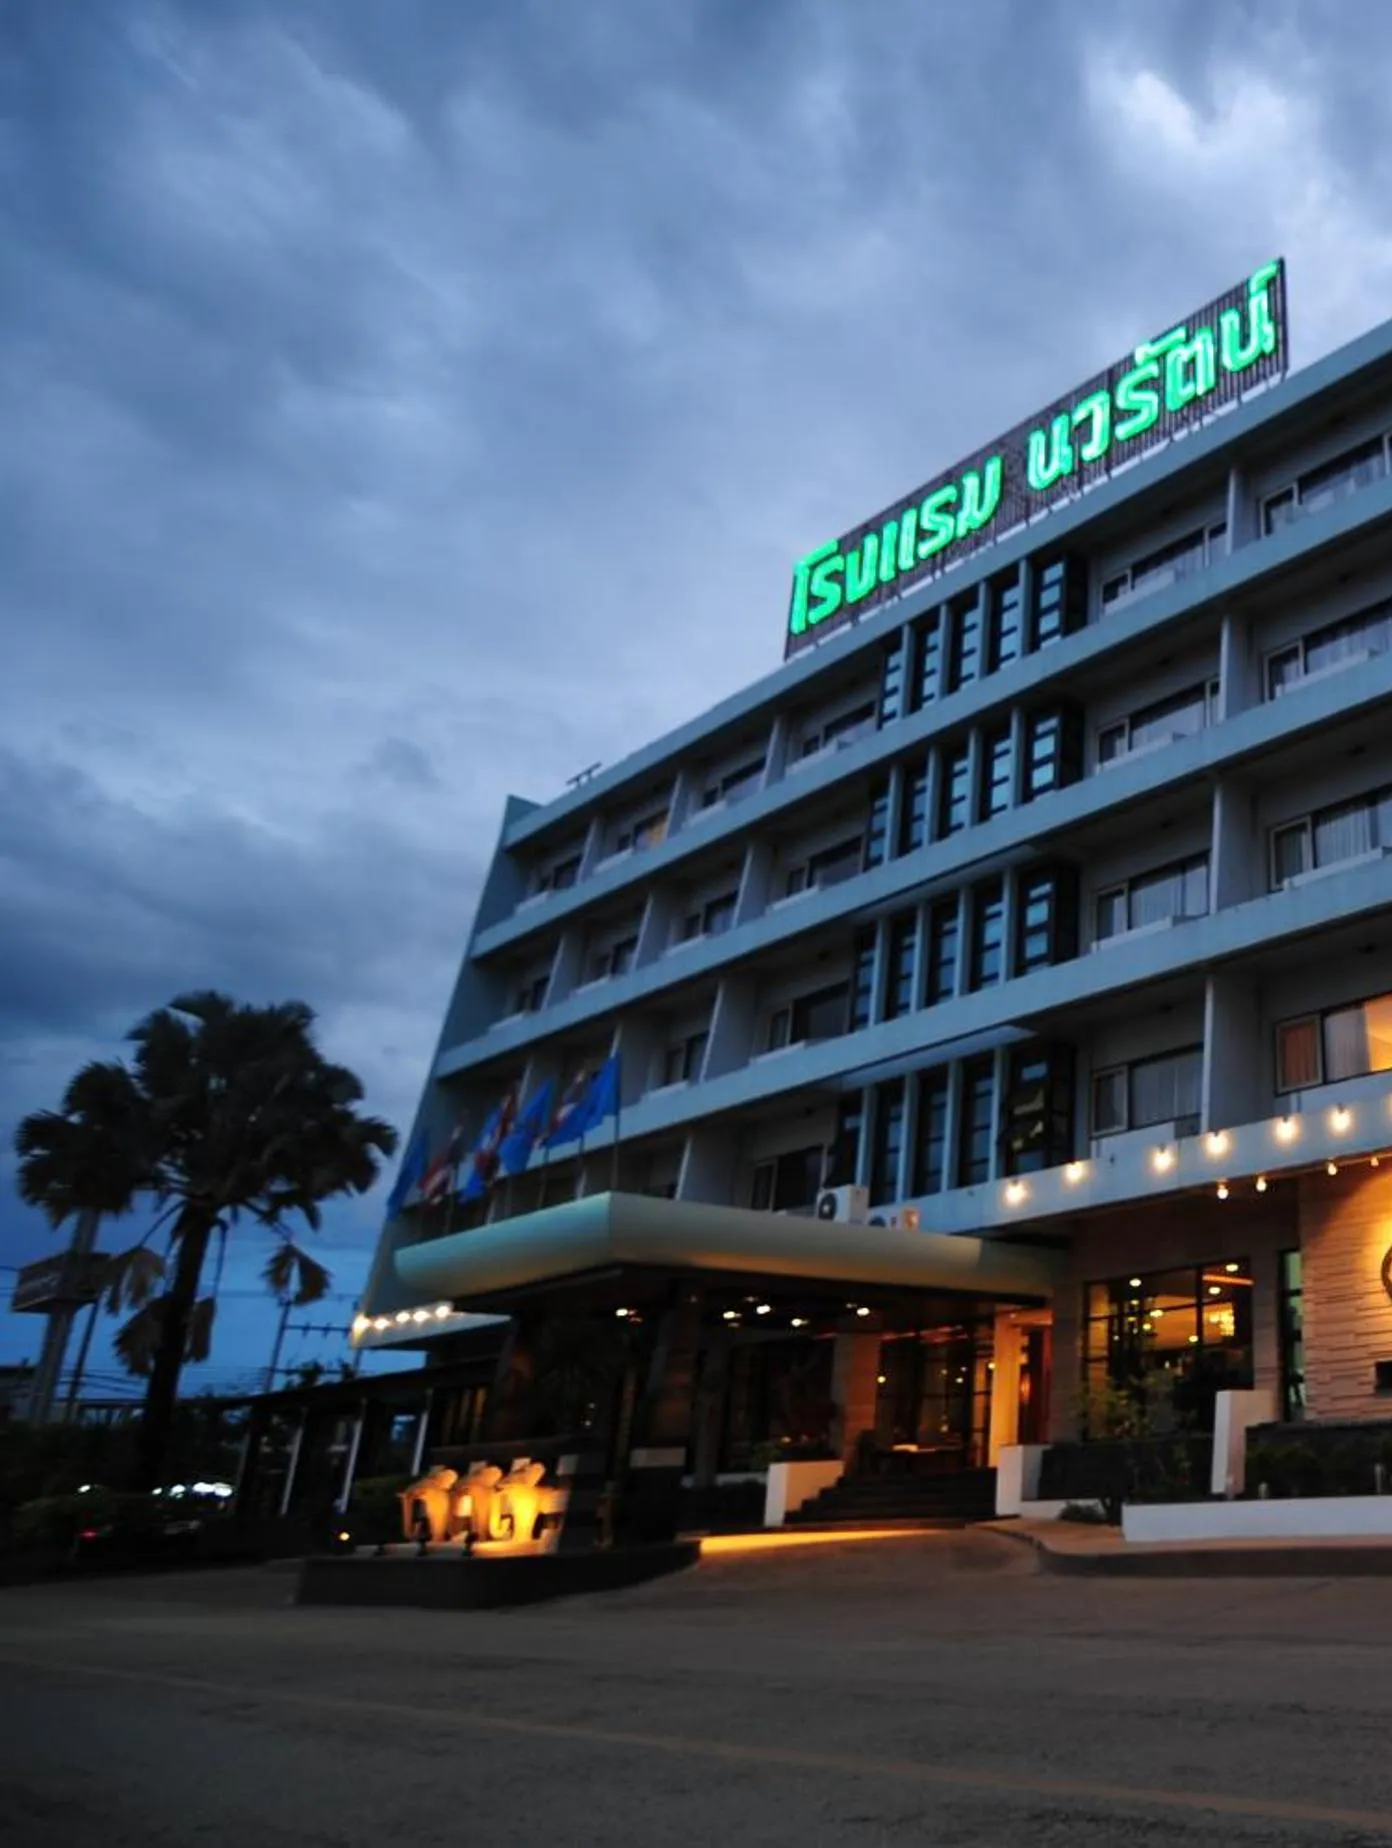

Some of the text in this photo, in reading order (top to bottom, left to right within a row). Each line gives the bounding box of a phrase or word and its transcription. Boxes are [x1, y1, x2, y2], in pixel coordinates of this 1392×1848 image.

[790, 258, 1278, 635] โรงแรม นวรัตน์
